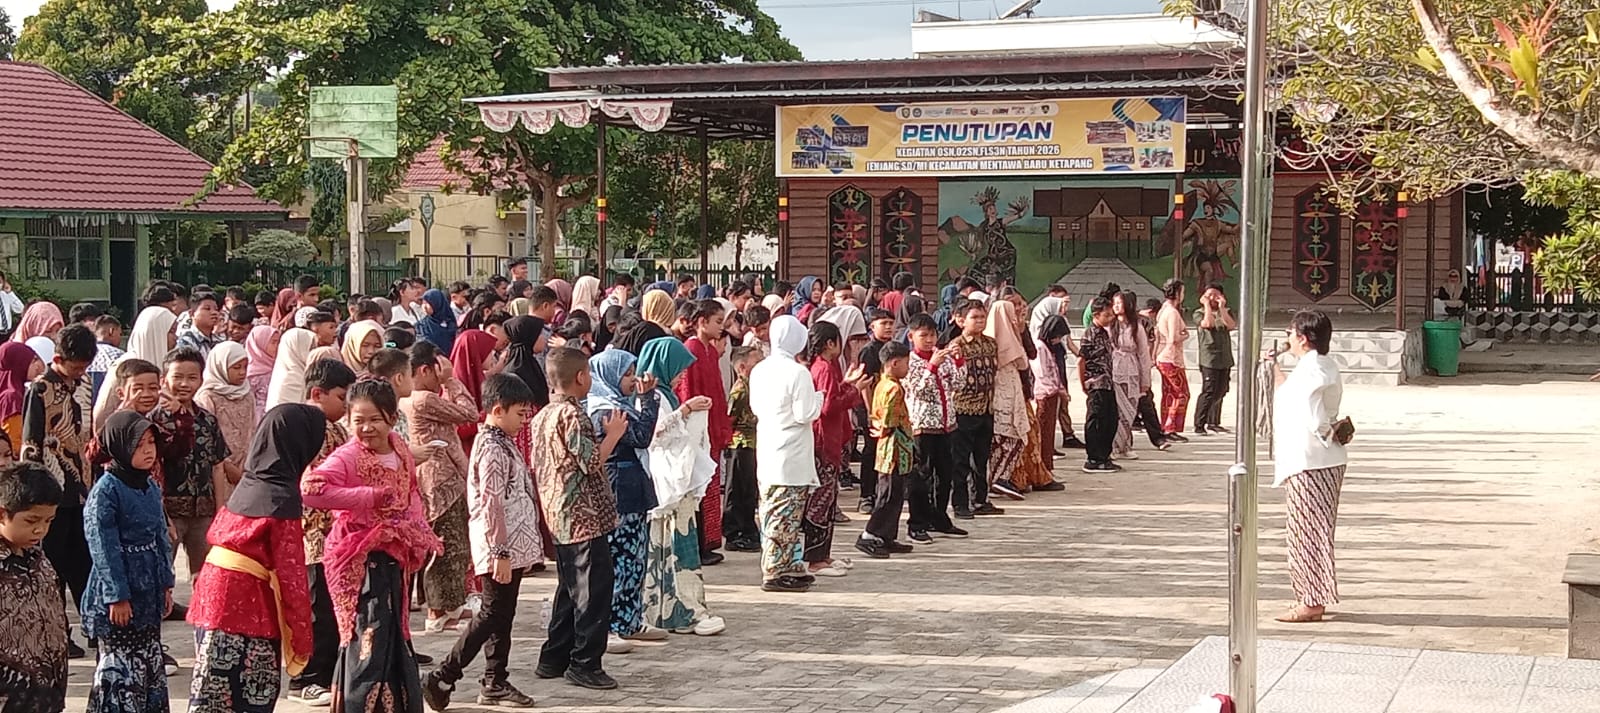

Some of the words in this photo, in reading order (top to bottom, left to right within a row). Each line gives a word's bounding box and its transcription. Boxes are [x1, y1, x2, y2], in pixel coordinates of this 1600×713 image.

[902, 121, 1053, 142] PENUTUPAN
[896, 148, 935, 158] KEGIATAN
[1007, 146, 1035, 155] TAHUN
[1037, 145, 1060, 155] 2026
[866, 162, 900, 172] JENJANG
[901, 161, 927, 171] SD/MI
[929, 160, 978, 171] KECAMATAN
[980, 160, 1022, 170] MENTAWA
[1024, 159, 1047, 169] BARU
[1049, 158, 1093, 169] KETAPANG
